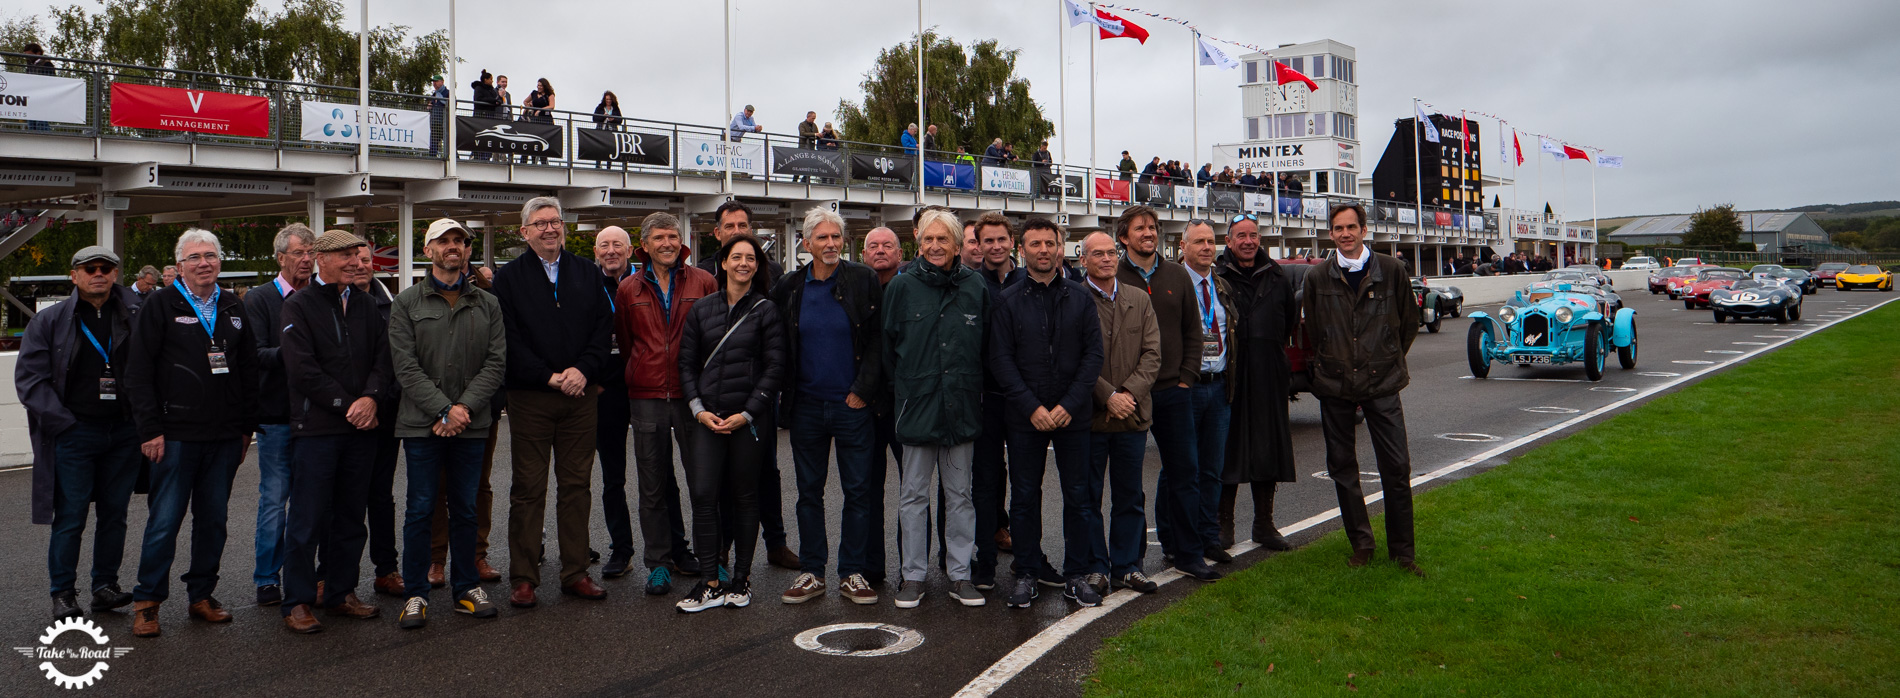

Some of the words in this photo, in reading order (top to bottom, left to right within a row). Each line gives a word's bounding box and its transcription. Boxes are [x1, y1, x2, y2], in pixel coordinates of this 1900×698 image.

[187, 91, 204, 113] V
[160, 119, 230, 131] MANAGEMENT
[356, 126, 414, 142] EALTH
[475, 140, 539, 152] VELOCE
[609, 132, 646, 160] JBR
[1238, 144, 1304, 159] MINTEX
[716, 156, 752, 169] WALTH
[1238, 162, 1269, 170] BRAKE
[148, 167, 155, 182] 5
[360, 178, 367, 192] 6
[1003, 180, 1025, 190] WEALTH
[601, 190, 607, 202] 7
[831, 202, 837, 212] 9
[1057, 215, 1067, 224] 12
[1513, 355, 1532, 364] LSJ
[1533, 355, 1550, 364] 236
